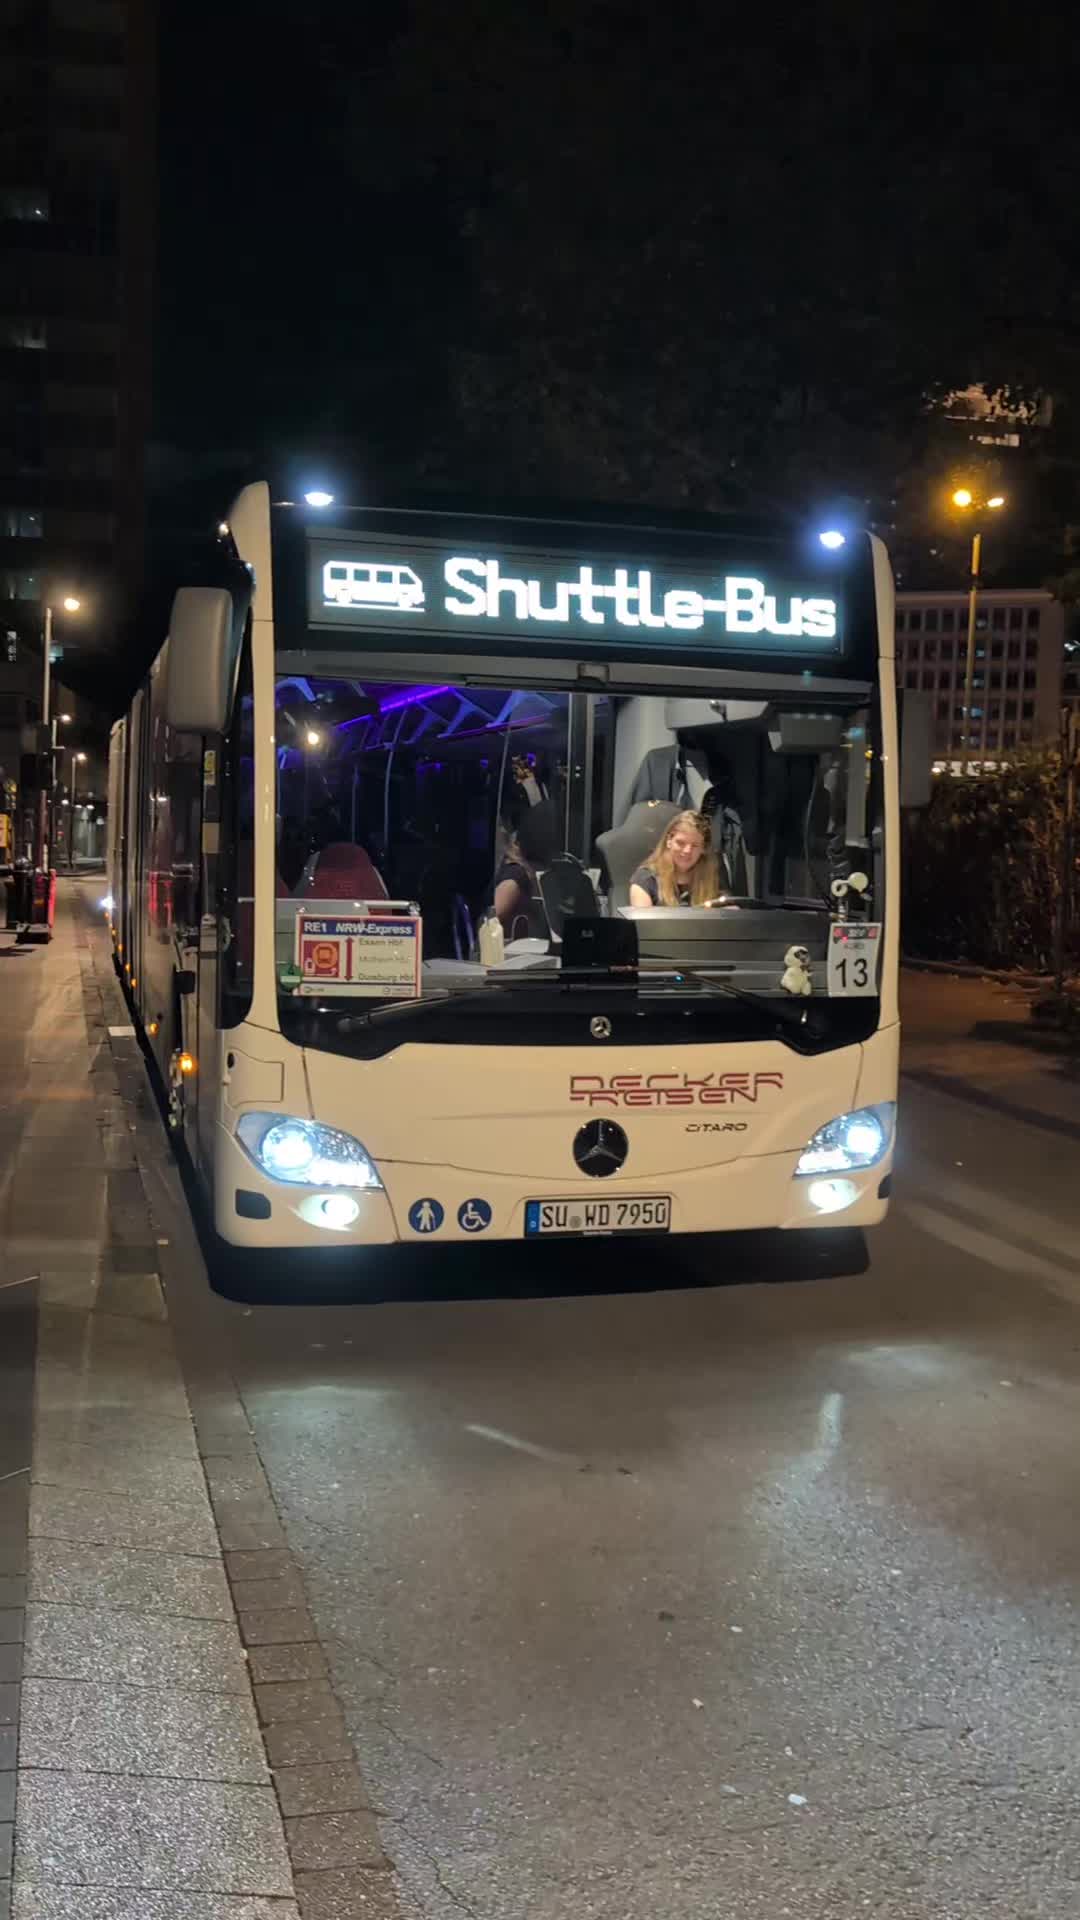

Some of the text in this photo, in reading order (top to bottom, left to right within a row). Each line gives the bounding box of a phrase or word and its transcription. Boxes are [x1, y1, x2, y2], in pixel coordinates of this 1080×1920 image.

[443, 556, 837, 638] Shuttle-Bus
[303, 921, 412, 935] RE1 NRW-Express
[835, 958, 868, 987] 13
[570, 1072, 783, 1093] DECKER
[571, 1087, 757, 1107] REISEN
[542, 1205, 568, 1227] SU
[585, 1204, 610, 1226] WD
[617, 1202, 666, 1225] 7950
